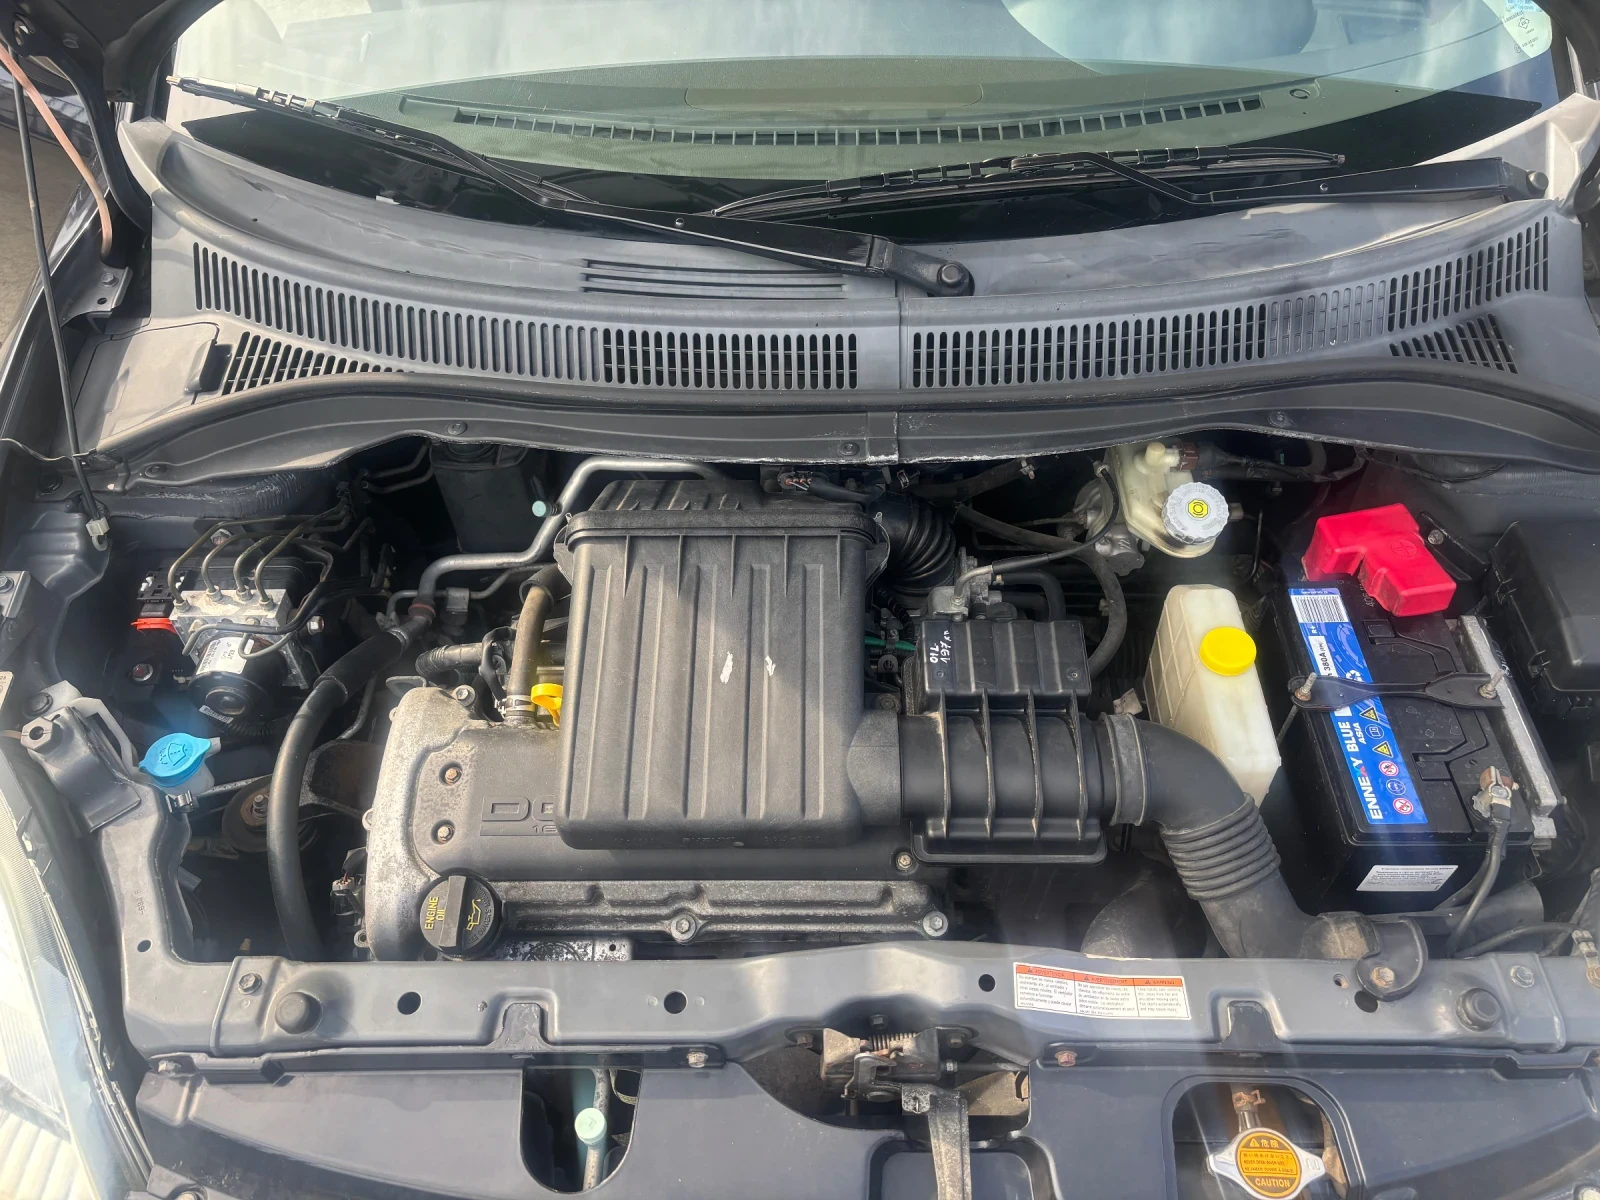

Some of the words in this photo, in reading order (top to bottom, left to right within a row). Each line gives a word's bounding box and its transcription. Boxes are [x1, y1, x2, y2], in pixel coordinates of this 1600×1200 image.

[1319, 652, 1330, 672] 380A
[1338, 722, 1359, 752] BLUE
[1352, 722, 1366, 744] ASIA
[424, 896, 440, 930] ENGINE
[436, 906, 446, 921] OIL
[1255, 1178, 1290, 1187] CAUTION
